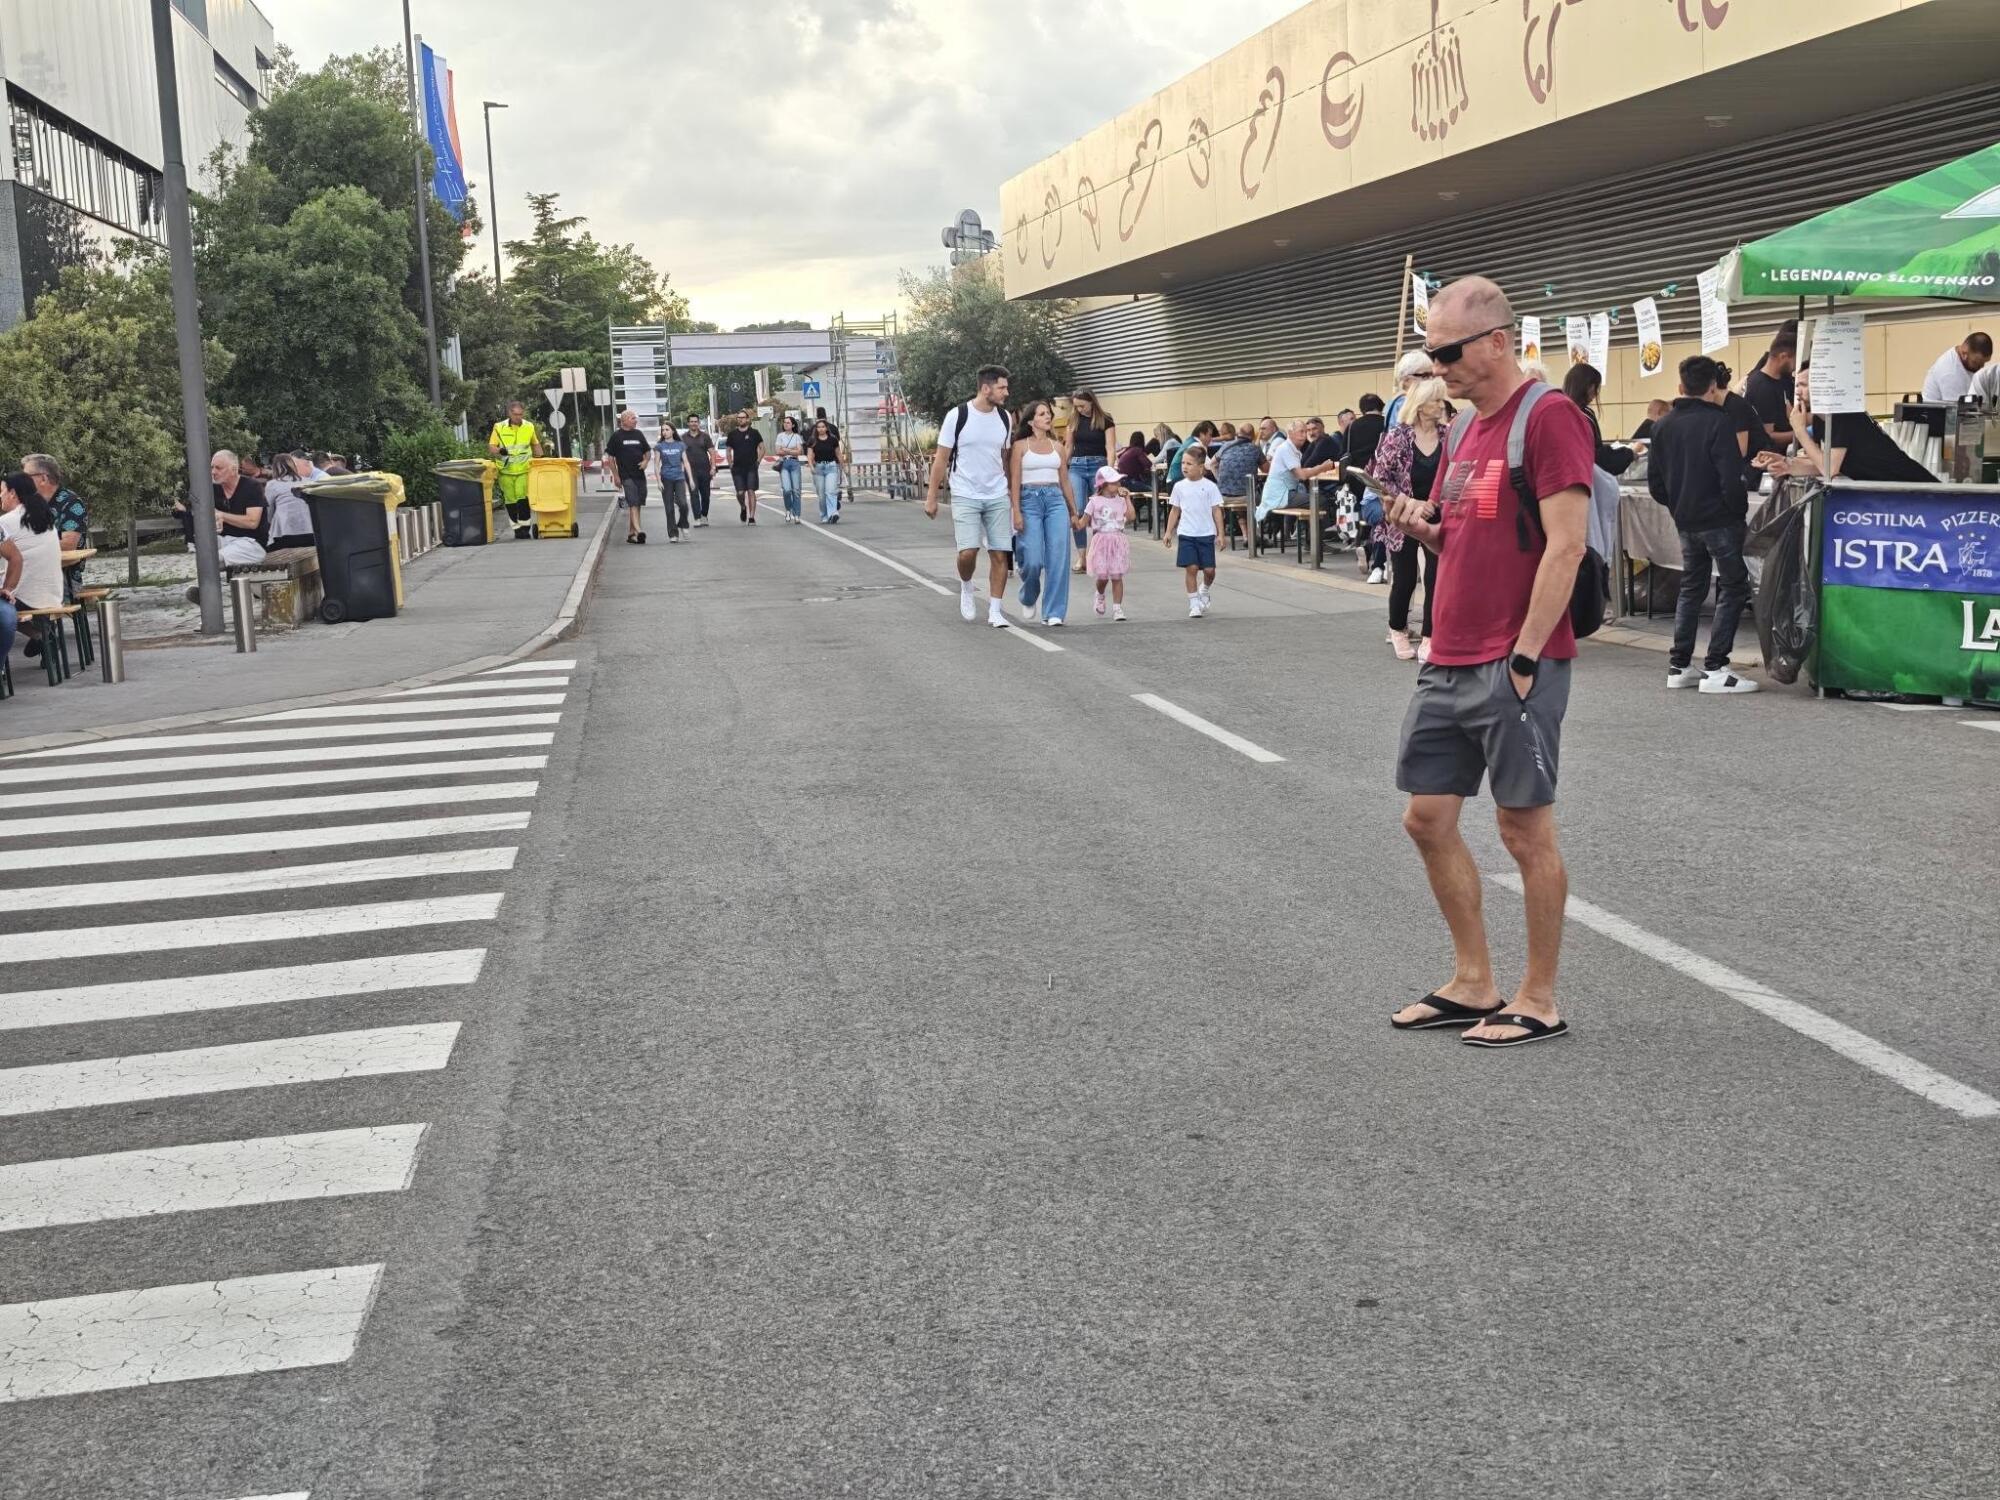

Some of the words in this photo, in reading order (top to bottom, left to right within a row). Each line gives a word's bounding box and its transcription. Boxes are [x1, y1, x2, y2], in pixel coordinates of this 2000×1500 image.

[1771, 268, 1883, 282] LEGENDARNO
[1887, 273, 1996, 286] SLOVENSKO
[1833, 511, 1926, 528] GOSTILNA
[1940, 511, 2000, 532] PIZZER
[1833, 538, 1949, 574] ISTRA
